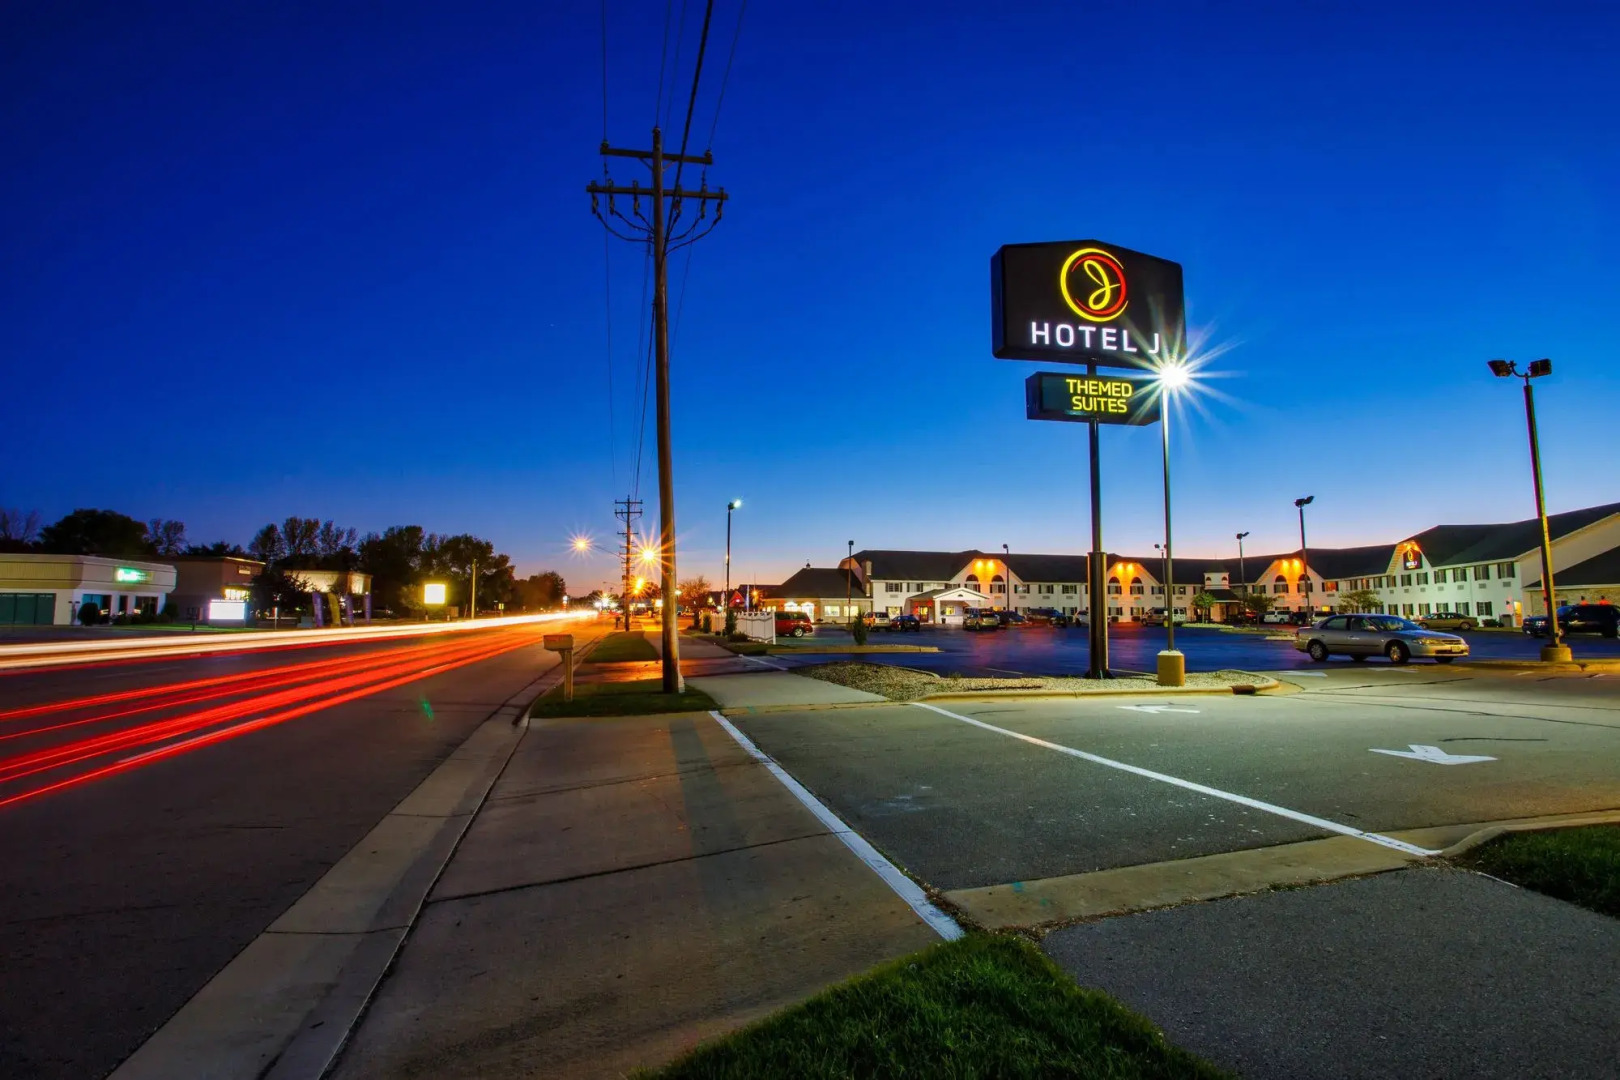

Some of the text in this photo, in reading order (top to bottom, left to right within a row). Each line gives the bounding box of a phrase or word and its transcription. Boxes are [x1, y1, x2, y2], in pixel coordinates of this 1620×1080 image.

[1031, 321, 1160, 354] HOTEL J
[1065, 378, 1133, 398] THEMED
[1071, 396, 1128, 413] SUITES
